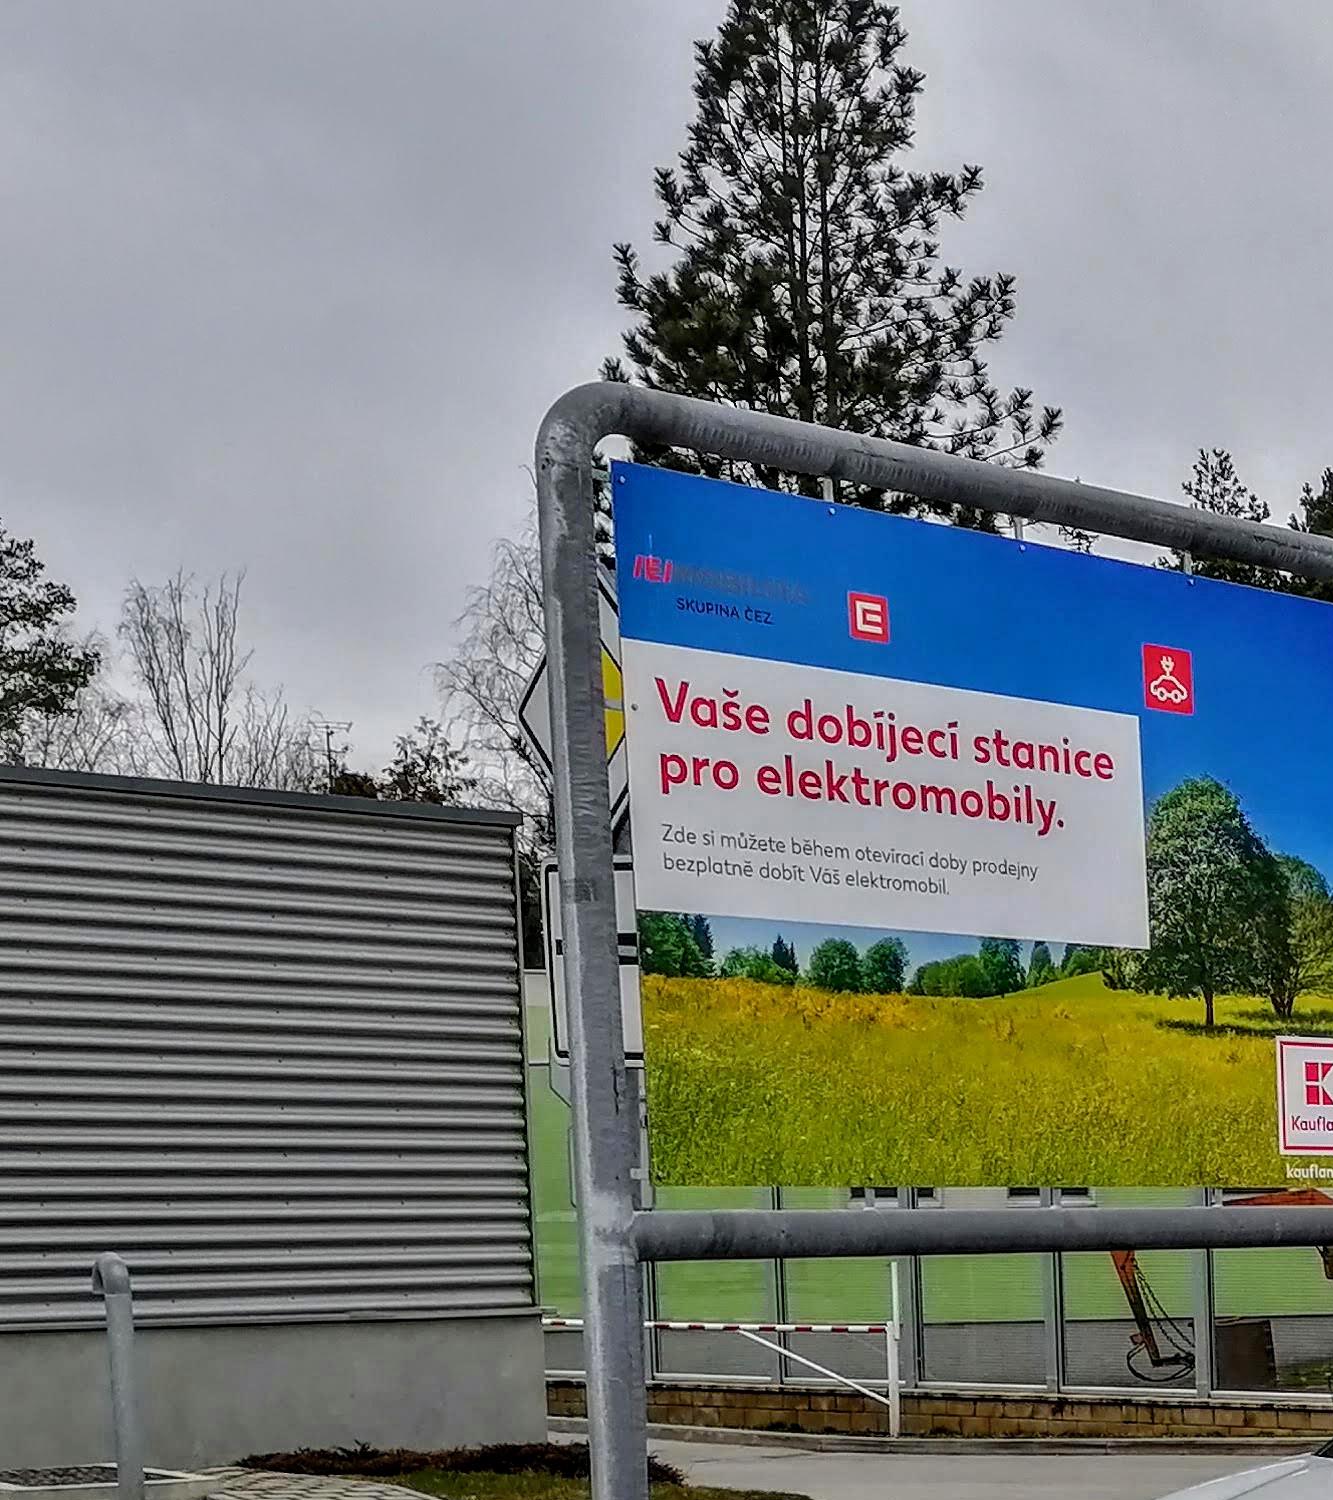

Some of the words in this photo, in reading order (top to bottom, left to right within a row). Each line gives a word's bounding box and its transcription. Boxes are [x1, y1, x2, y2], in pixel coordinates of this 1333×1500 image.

[676, 597, 740, 619] SKUPINA
[744, 606, 774, 625] ČEZ
[654, 677, 770, 735] Vaše
[786, 698, 959, 763] dobíjecí
[973, 729, 1114, 780] stanice
[659, 753, 740, 795] pro
[756, 754, 1065, 836] elektromobily.
[661, 823, 697, 845] Zde
[702, 830, 715, 847] si
[720, 832, 786, 854] můžete
[791, 836, 850, 860] během
[855, 847, 925, 867] otevírací
[928, 852, 968, 876] doby
[972, 859, 1038, 882] prodejny
[663, 852, 754, 877] bezplatně
[758, 861, 806, 882] dobít
[809, 865, 841, 886] Váš
[845, 871, 950, 896] elektromobil.
